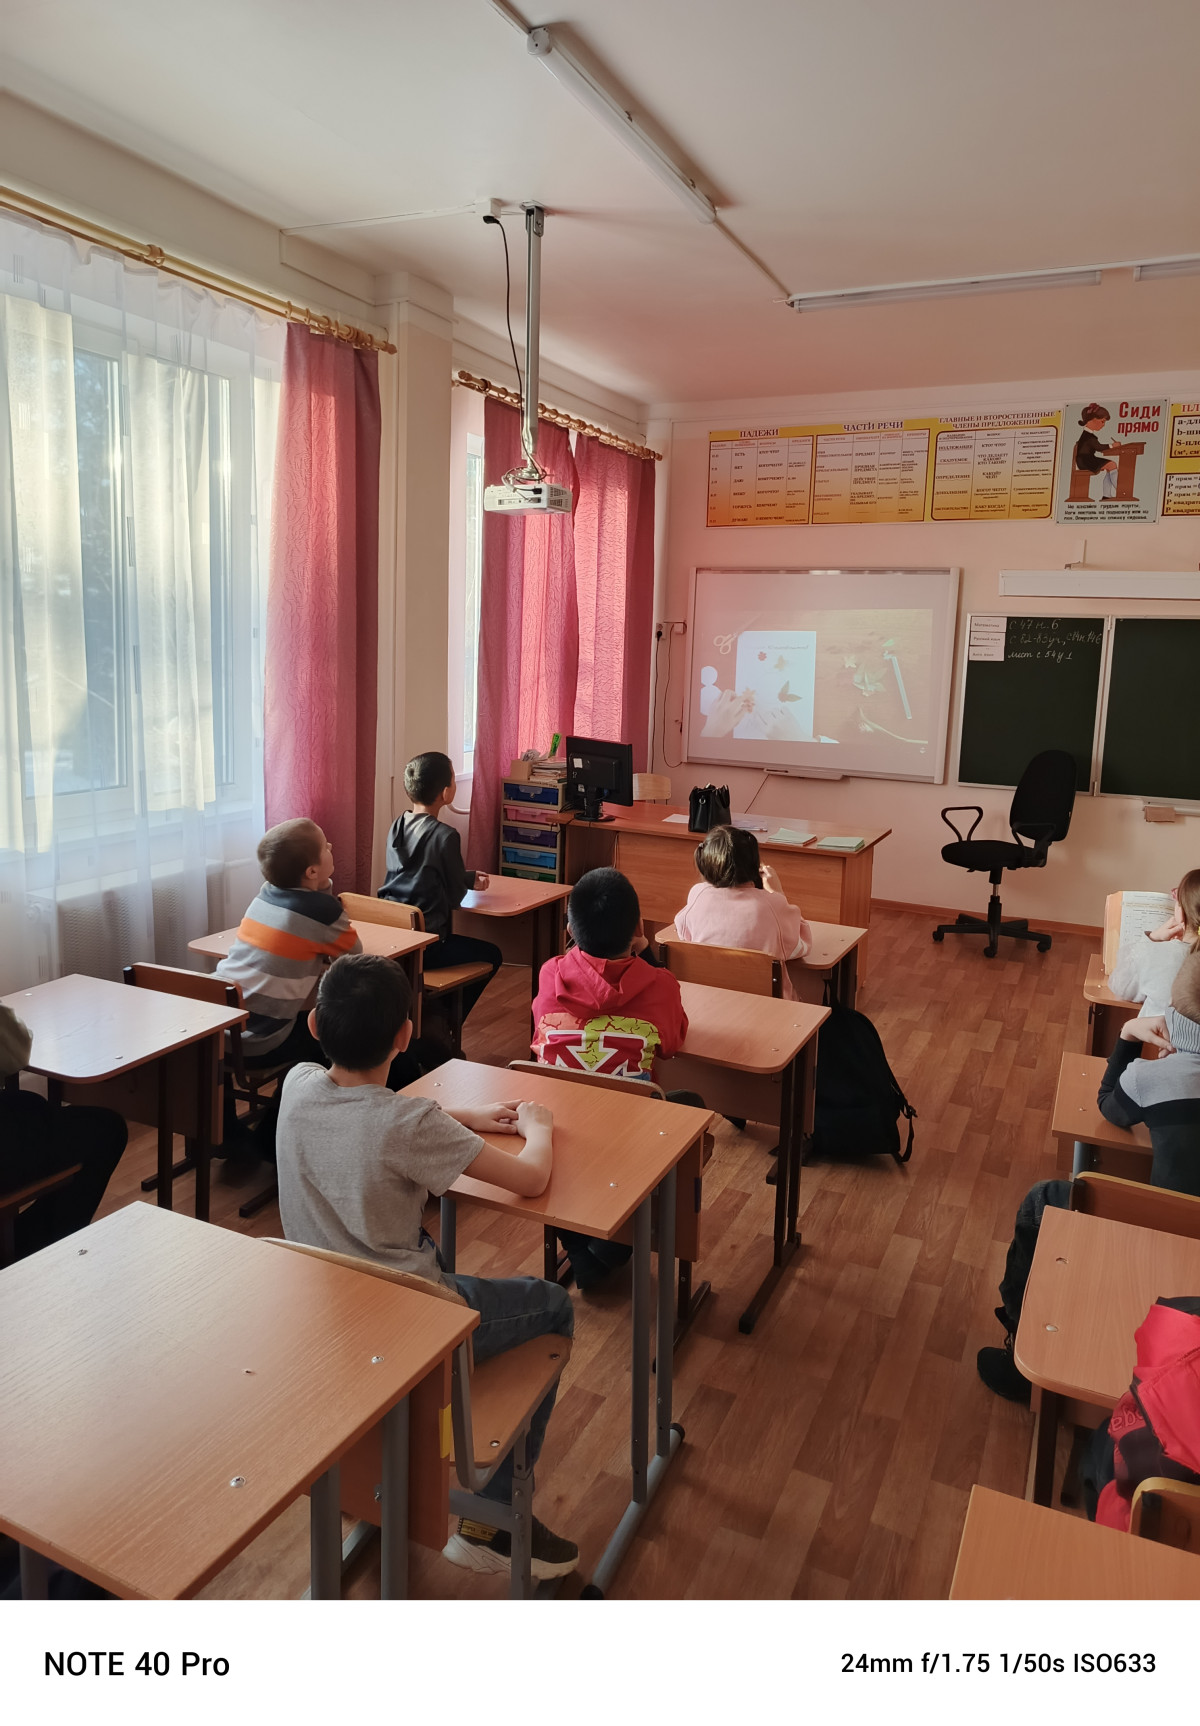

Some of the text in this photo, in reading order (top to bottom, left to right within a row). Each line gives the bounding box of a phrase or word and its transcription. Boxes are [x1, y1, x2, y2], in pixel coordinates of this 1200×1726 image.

[1119, 402, 1160, 419] Сиди
[983, 412, 1055, 421] ВТОРОСТЕПЕННЫЕ
[843, 421, 903, 431] ЧАСТИ РЕЧИ
[981, 419, 1040, 428] ПРЕДЛОЖЕНИЯ
[740, 429, 779, 438] ПАДЕЖИ
[1118, 421, 1159, 437] прямо
